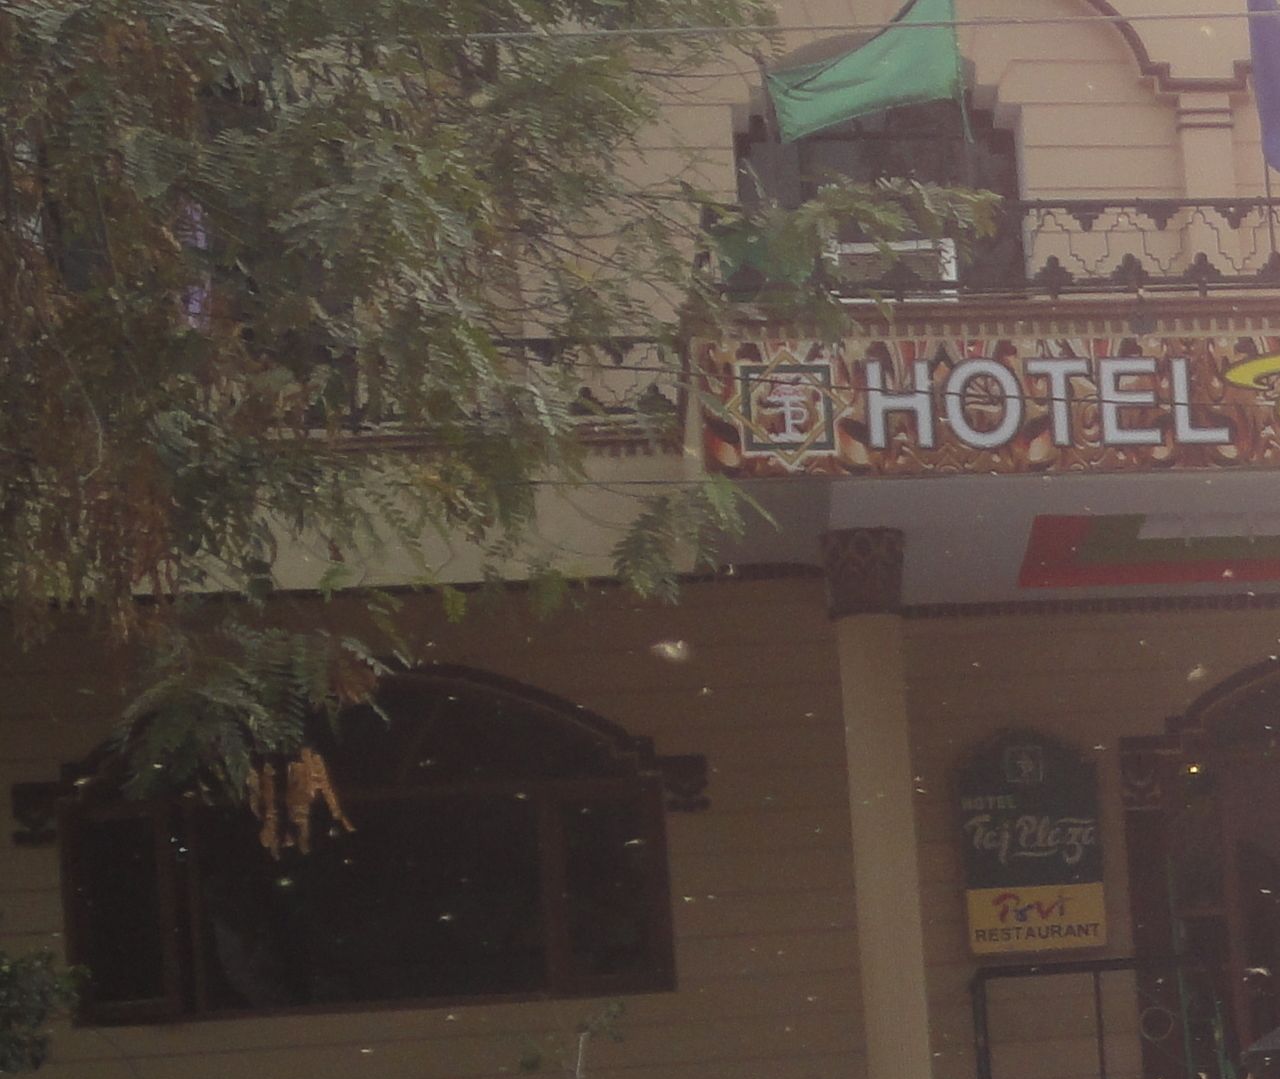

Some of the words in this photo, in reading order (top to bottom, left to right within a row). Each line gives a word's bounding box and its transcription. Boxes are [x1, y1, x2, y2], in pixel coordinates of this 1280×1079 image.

[864, 355, 1231, 450] HOTEL
[961, 794, 1017, 810] HOTEL
[963, 814, 1010, 864] Taj
[974, 922, 1100, 942] RESTAURANT
